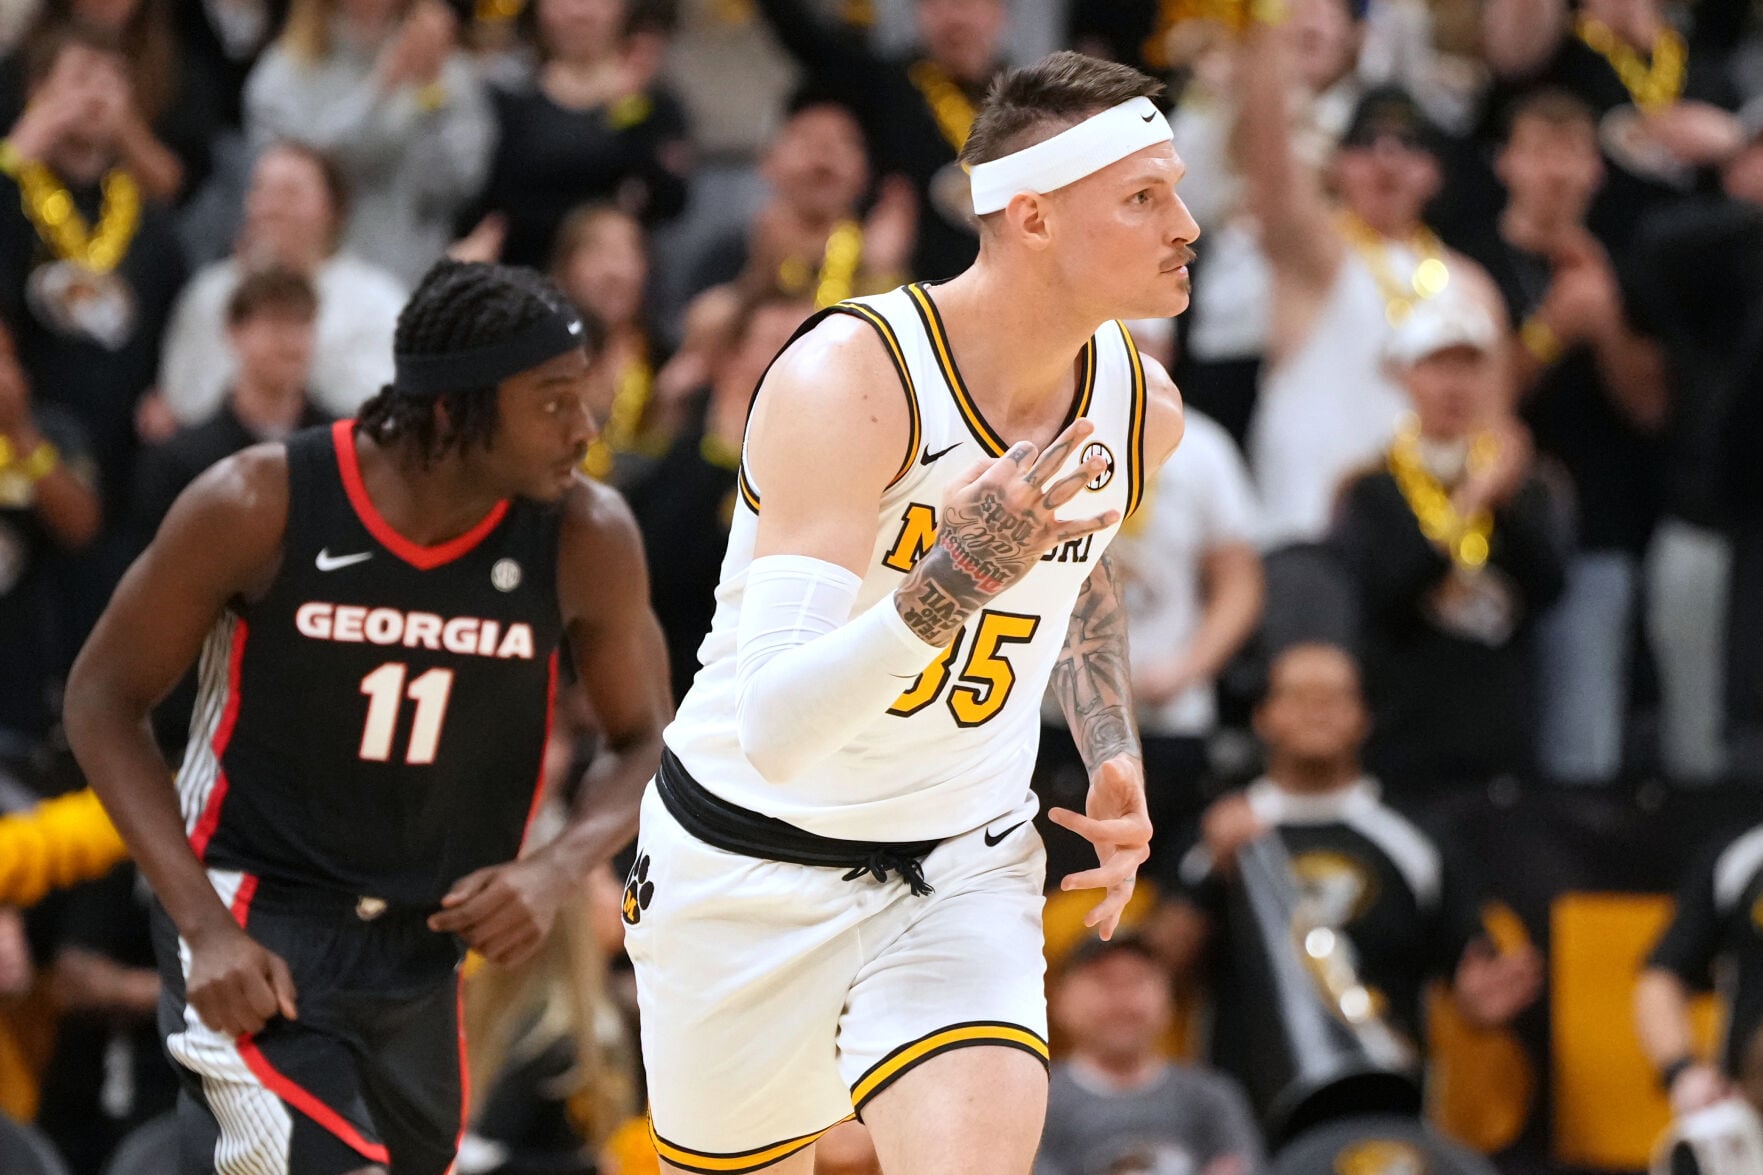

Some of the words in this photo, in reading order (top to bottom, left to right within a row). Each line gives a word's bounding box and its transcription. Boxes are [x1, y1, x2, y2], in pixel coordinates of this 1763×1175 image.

[296, 601, 535, 659] GEORGIA
[903, 606, 941, 640] FEAR
[921, 608, 942, 625] NO
[358, 662, 455, 765] 11
